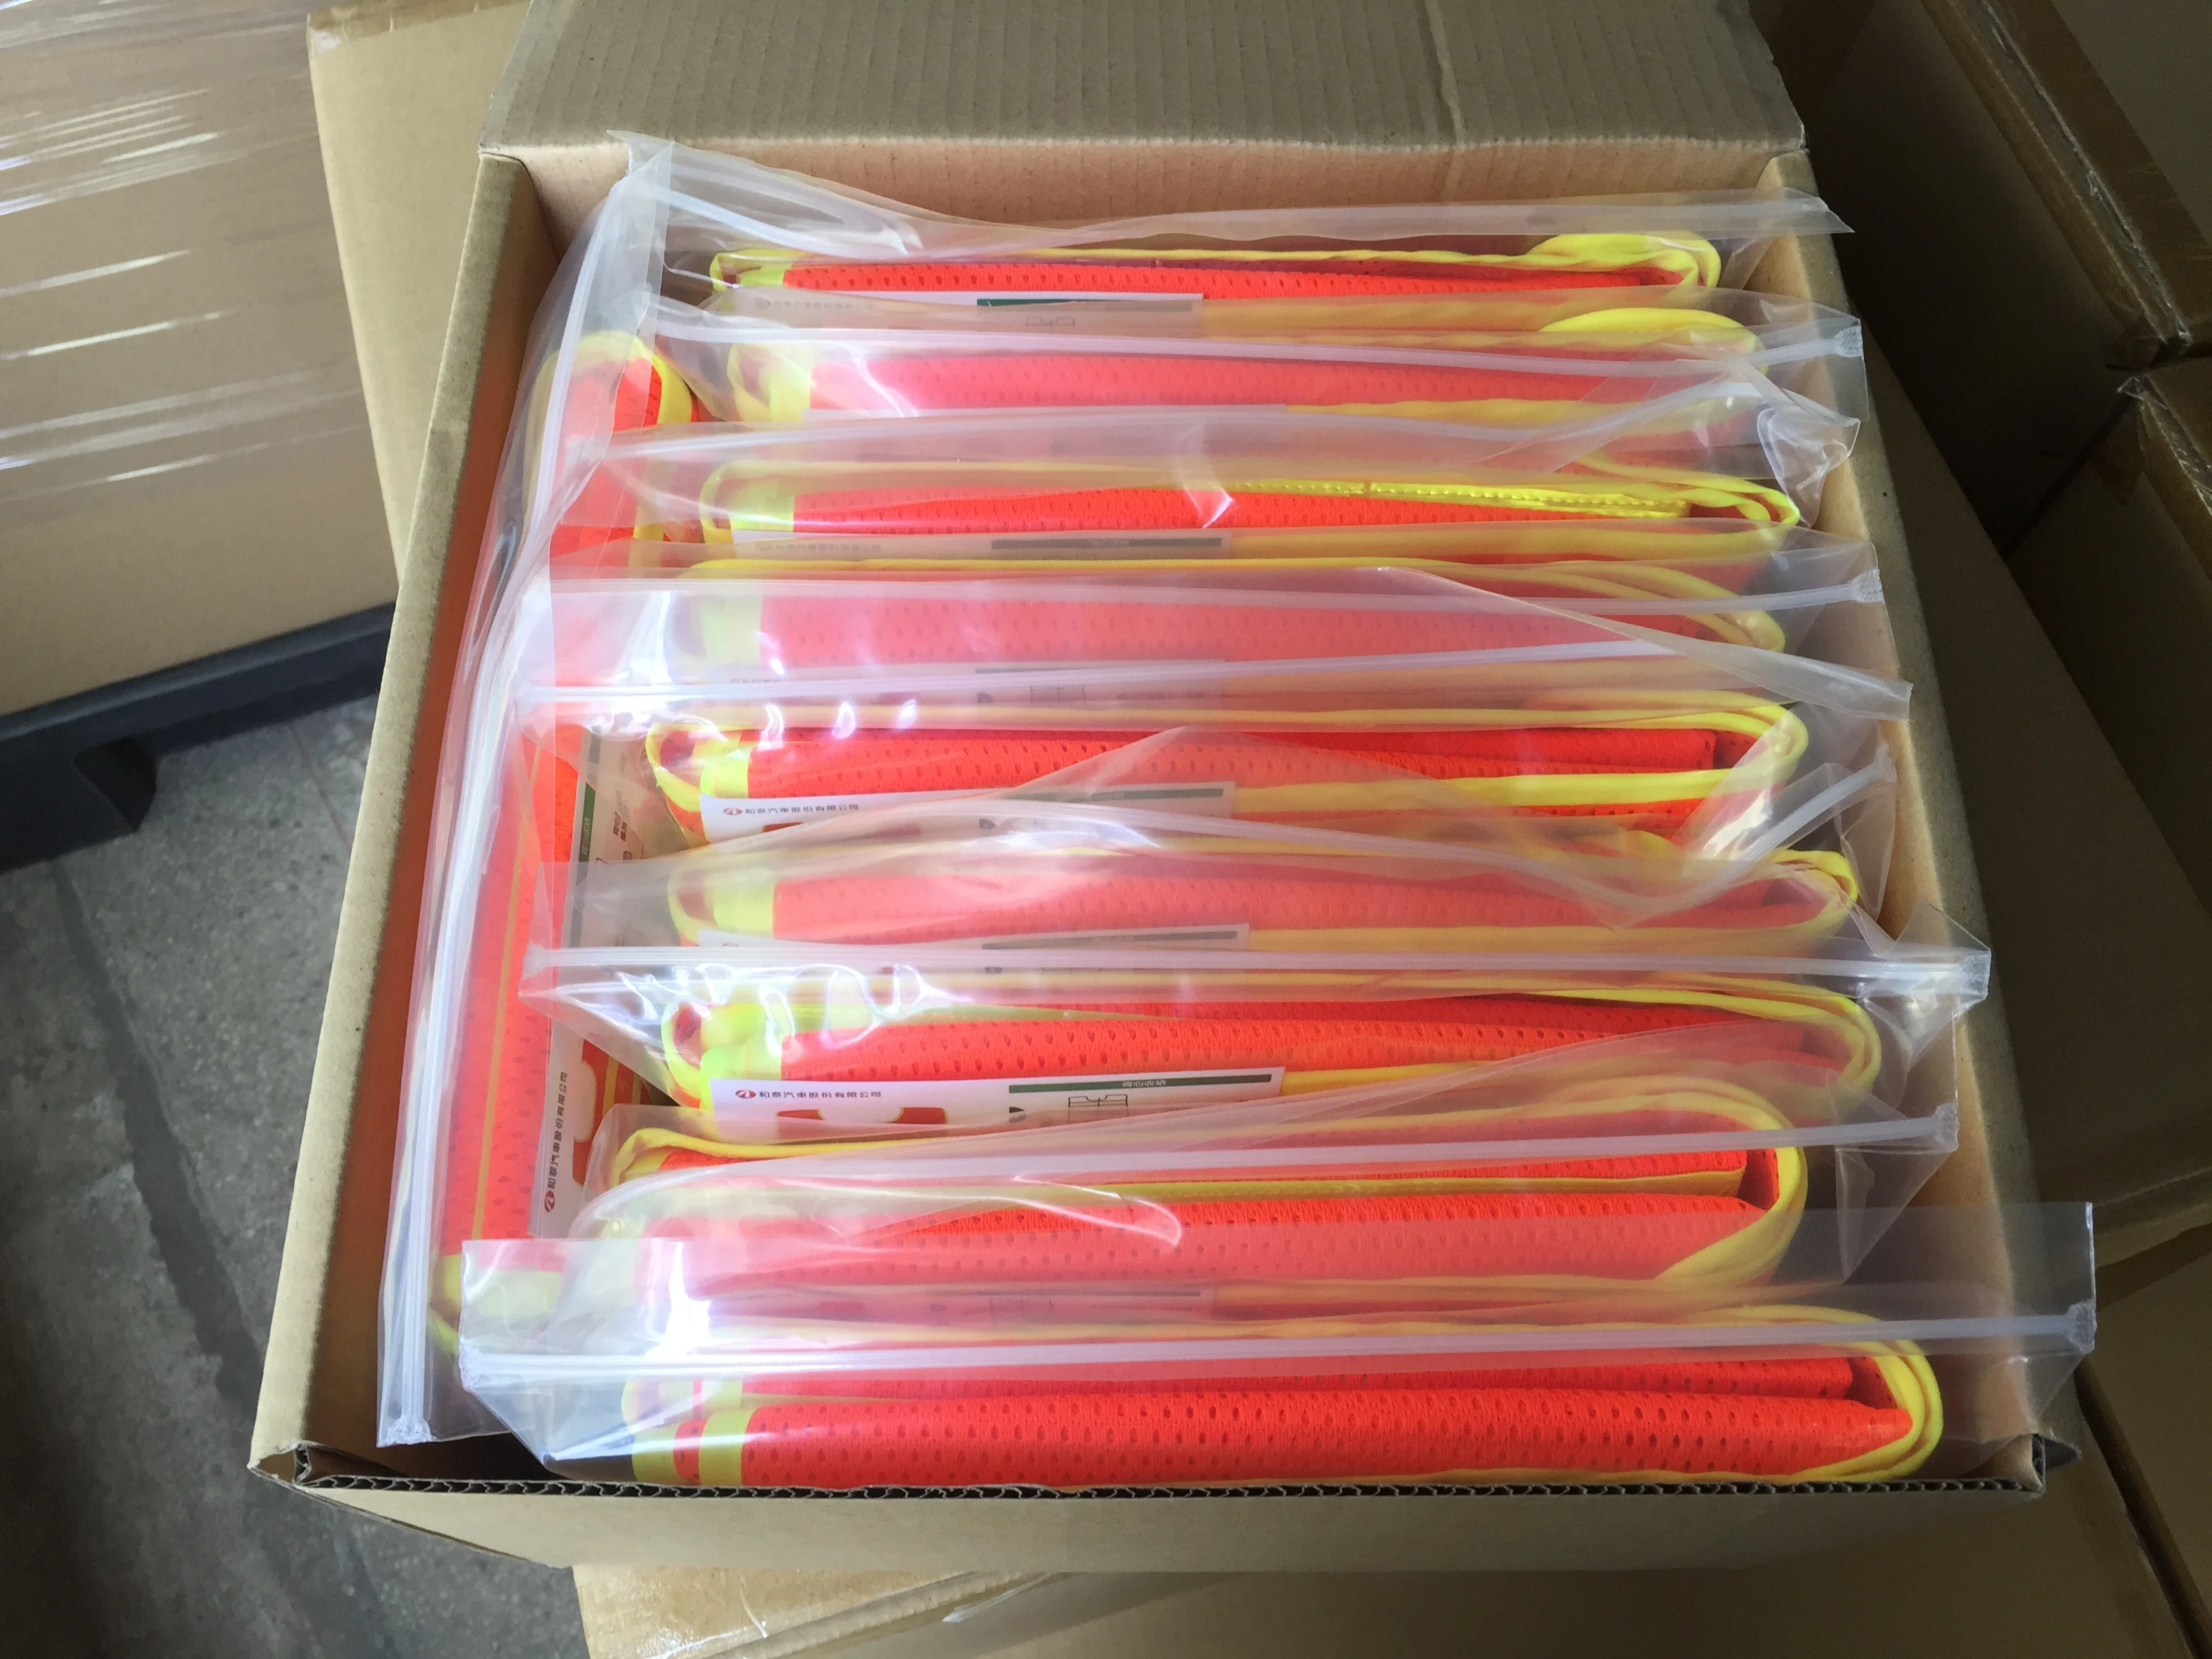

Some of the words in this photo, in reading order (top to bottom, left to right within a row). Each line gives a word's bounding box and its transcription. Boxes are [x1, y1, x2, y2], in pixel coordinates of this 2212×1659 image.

[547, 1071, 567, 1190] 和泰汽車股份有限公司
